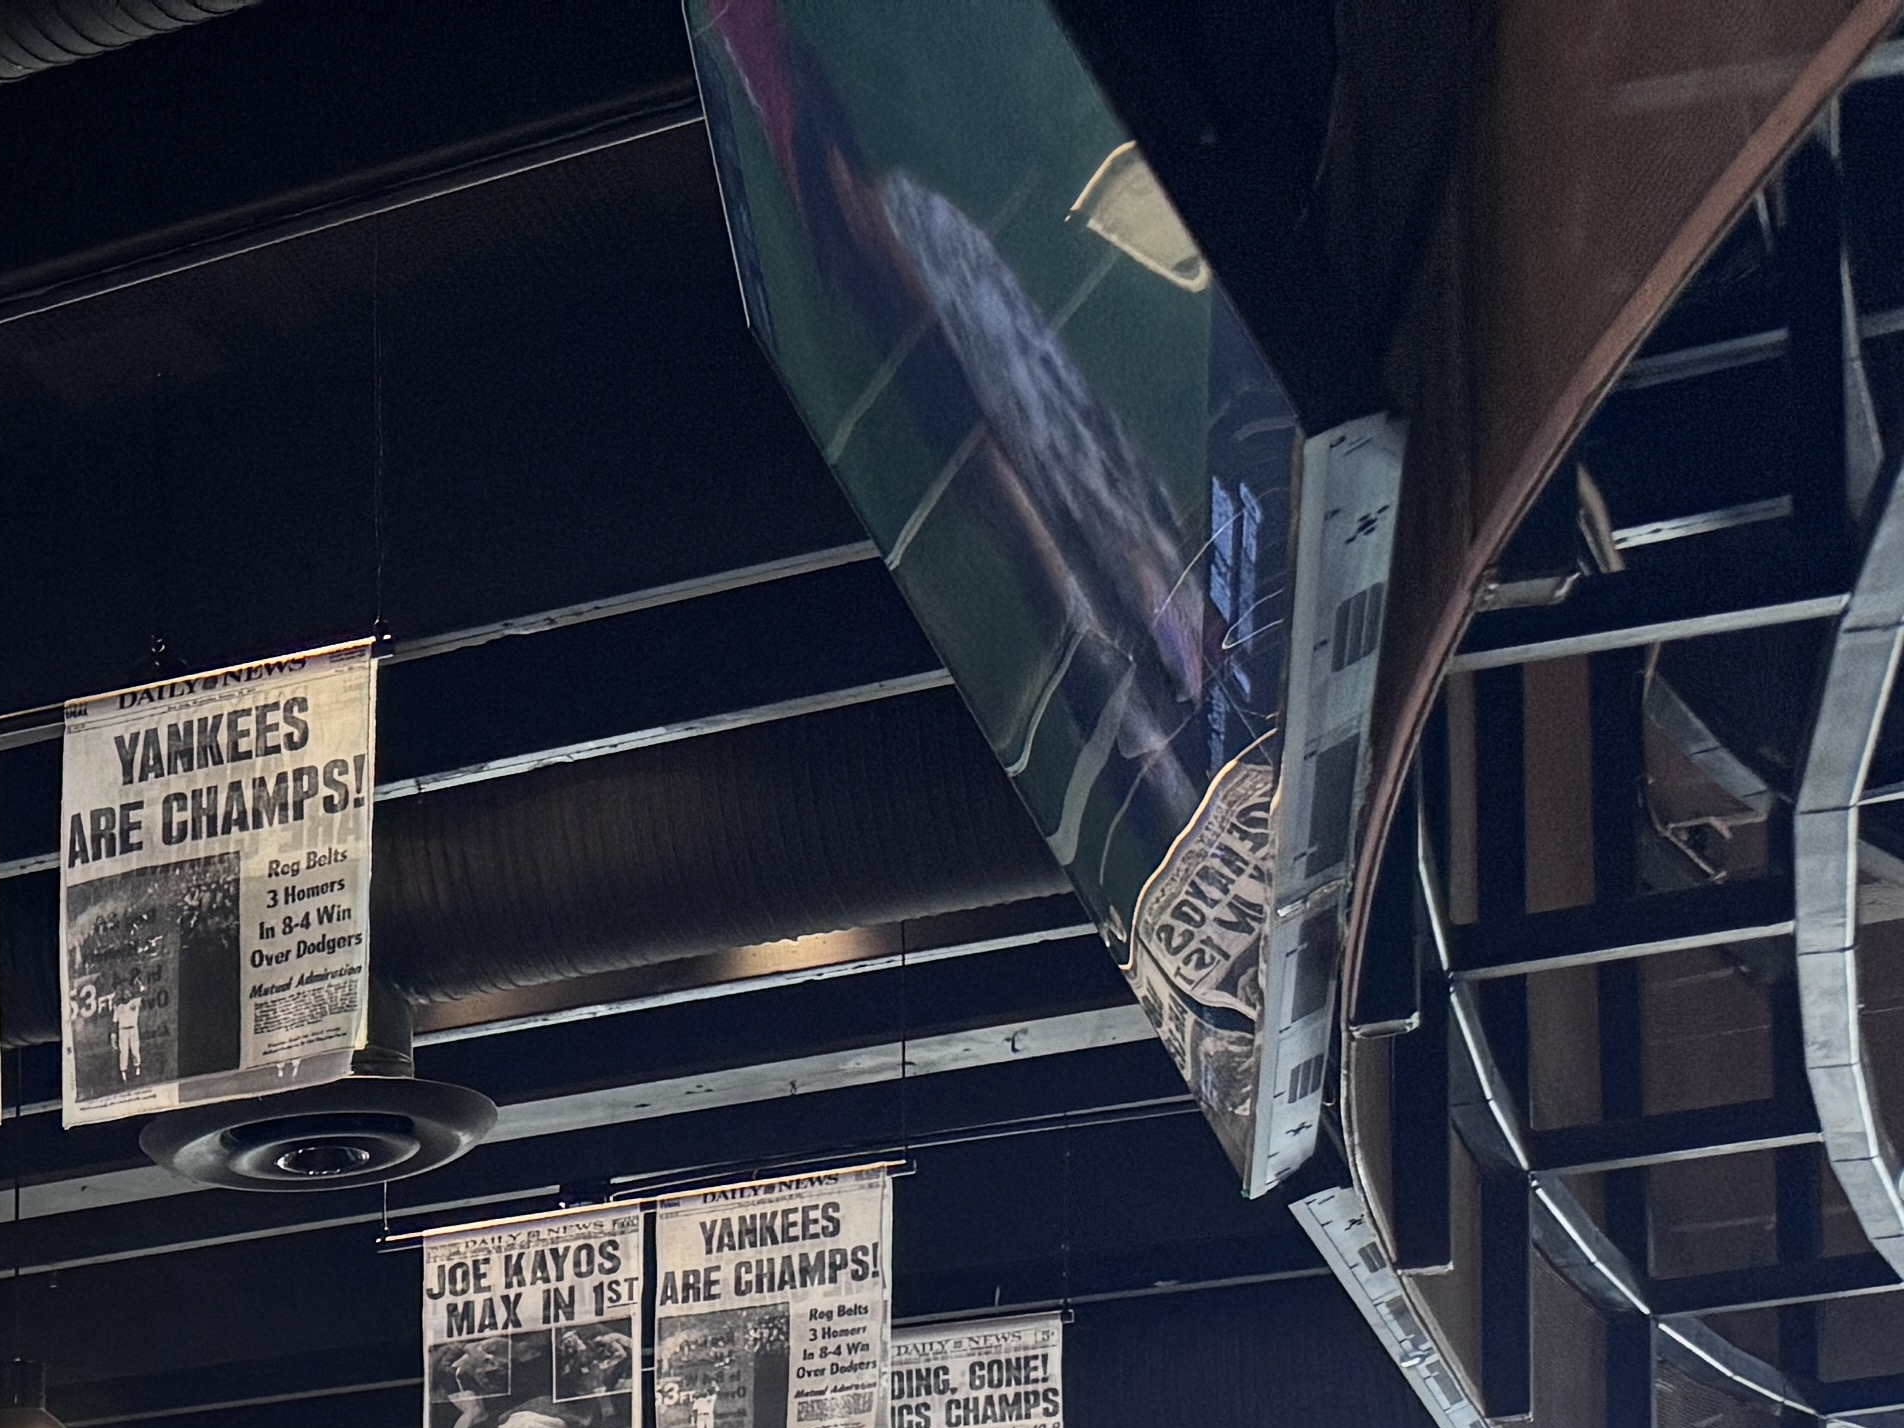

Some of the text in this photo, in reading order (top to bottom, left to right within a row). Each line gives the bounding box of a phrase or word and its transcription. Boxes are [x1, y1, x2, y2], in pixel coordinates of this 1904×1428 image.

[119, 657, 308, 710] DAILY NEWS
[114, 696, 310, 787] YANKEES
[67, 752, 366, 870] ARE CHAMPS!
[306, 846, 348, 871] Belts
[266, 877, 346, 909] 3 Homers
[258, 903, 352, 941] In 8-4 Win
[250, 931, 363, 969] Over Dodgers
[703, 1175, 839, 1204] DAILY NEWS
[464, 1220, 605, 1249] DAILY NEWS
[699, 1201, 841, 1255] YANKEES
[426, 1239, 622, 1300] JOE KAYOS
[659, 1241, 880, 1306] ARE CHAMPS!
[446, 1277, 639, 1339] MAX IN 1ST
[809, 1328, 818, 1342] 3
[819, 1344, 842, 1359] 8-4
[896, 1340, 948, 1357] DAILY
[968, 1329, 1023, 1346] NEWS
[969, 1353, 1049, 1391] GONE!
[945, 1387, 1060, 1428] CHAMPS
